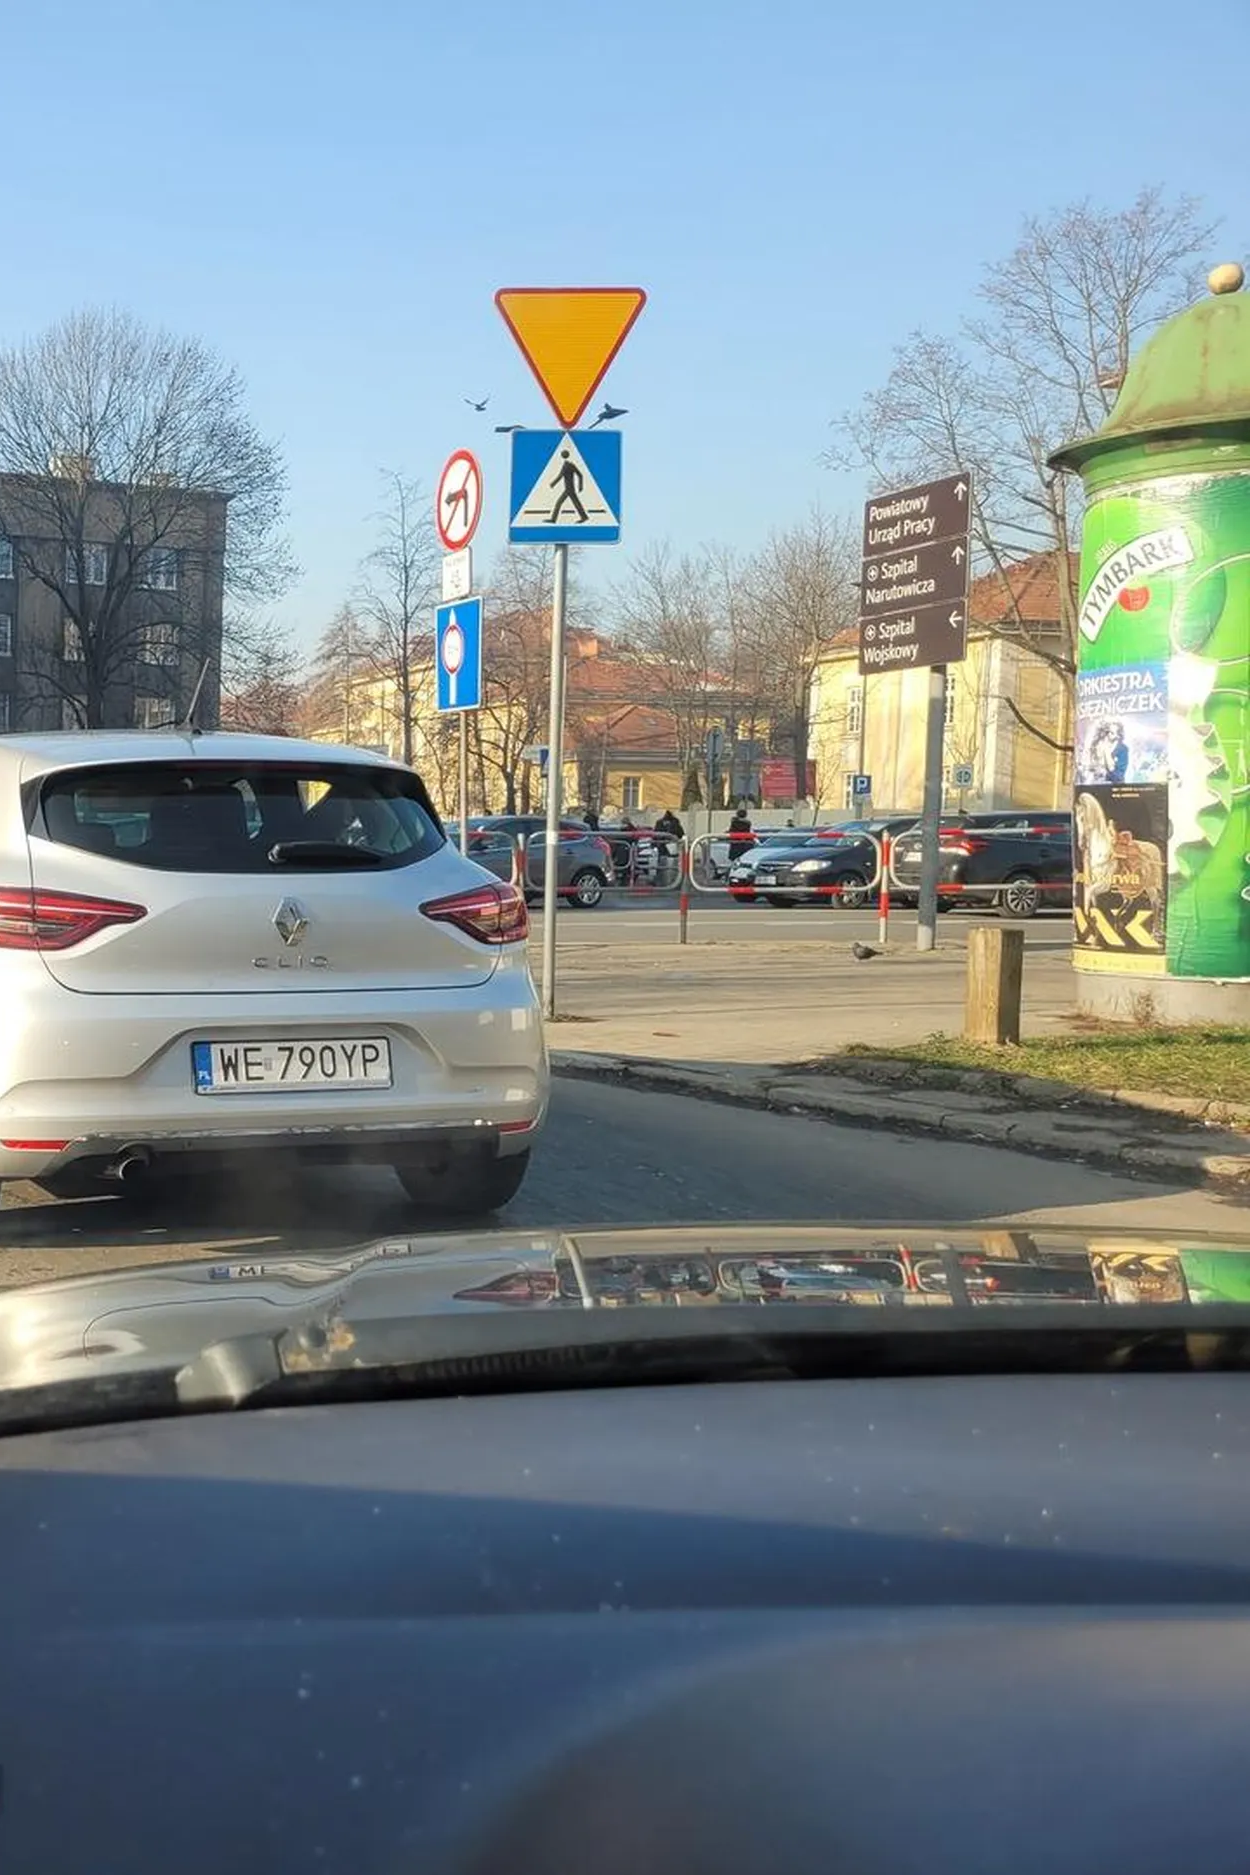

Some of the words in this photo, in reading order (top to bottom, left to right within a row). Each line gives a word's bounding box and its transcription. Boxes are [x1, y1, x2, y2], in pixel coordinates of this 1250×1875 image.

[869, 495, 929, 522] Powiatowy
[869, 521, 901, 544] Urząd
[903, 517, 935, 536] Pracy
[881, 555, 918, 580] Szpital
[865, 578, 935, 604] Narutowicza
[1081, 535, 1181, 628] TYMBARK
[878, 616, 915, 641] Szpital
[863, 643, 919, 666] Wojskowy
[856, 777, 868, 792] P
[251, 955, 328, 969] CLIO
[220, 1047, 265, 1082] WE
[277, 1044, 380, 1081] 790YP
